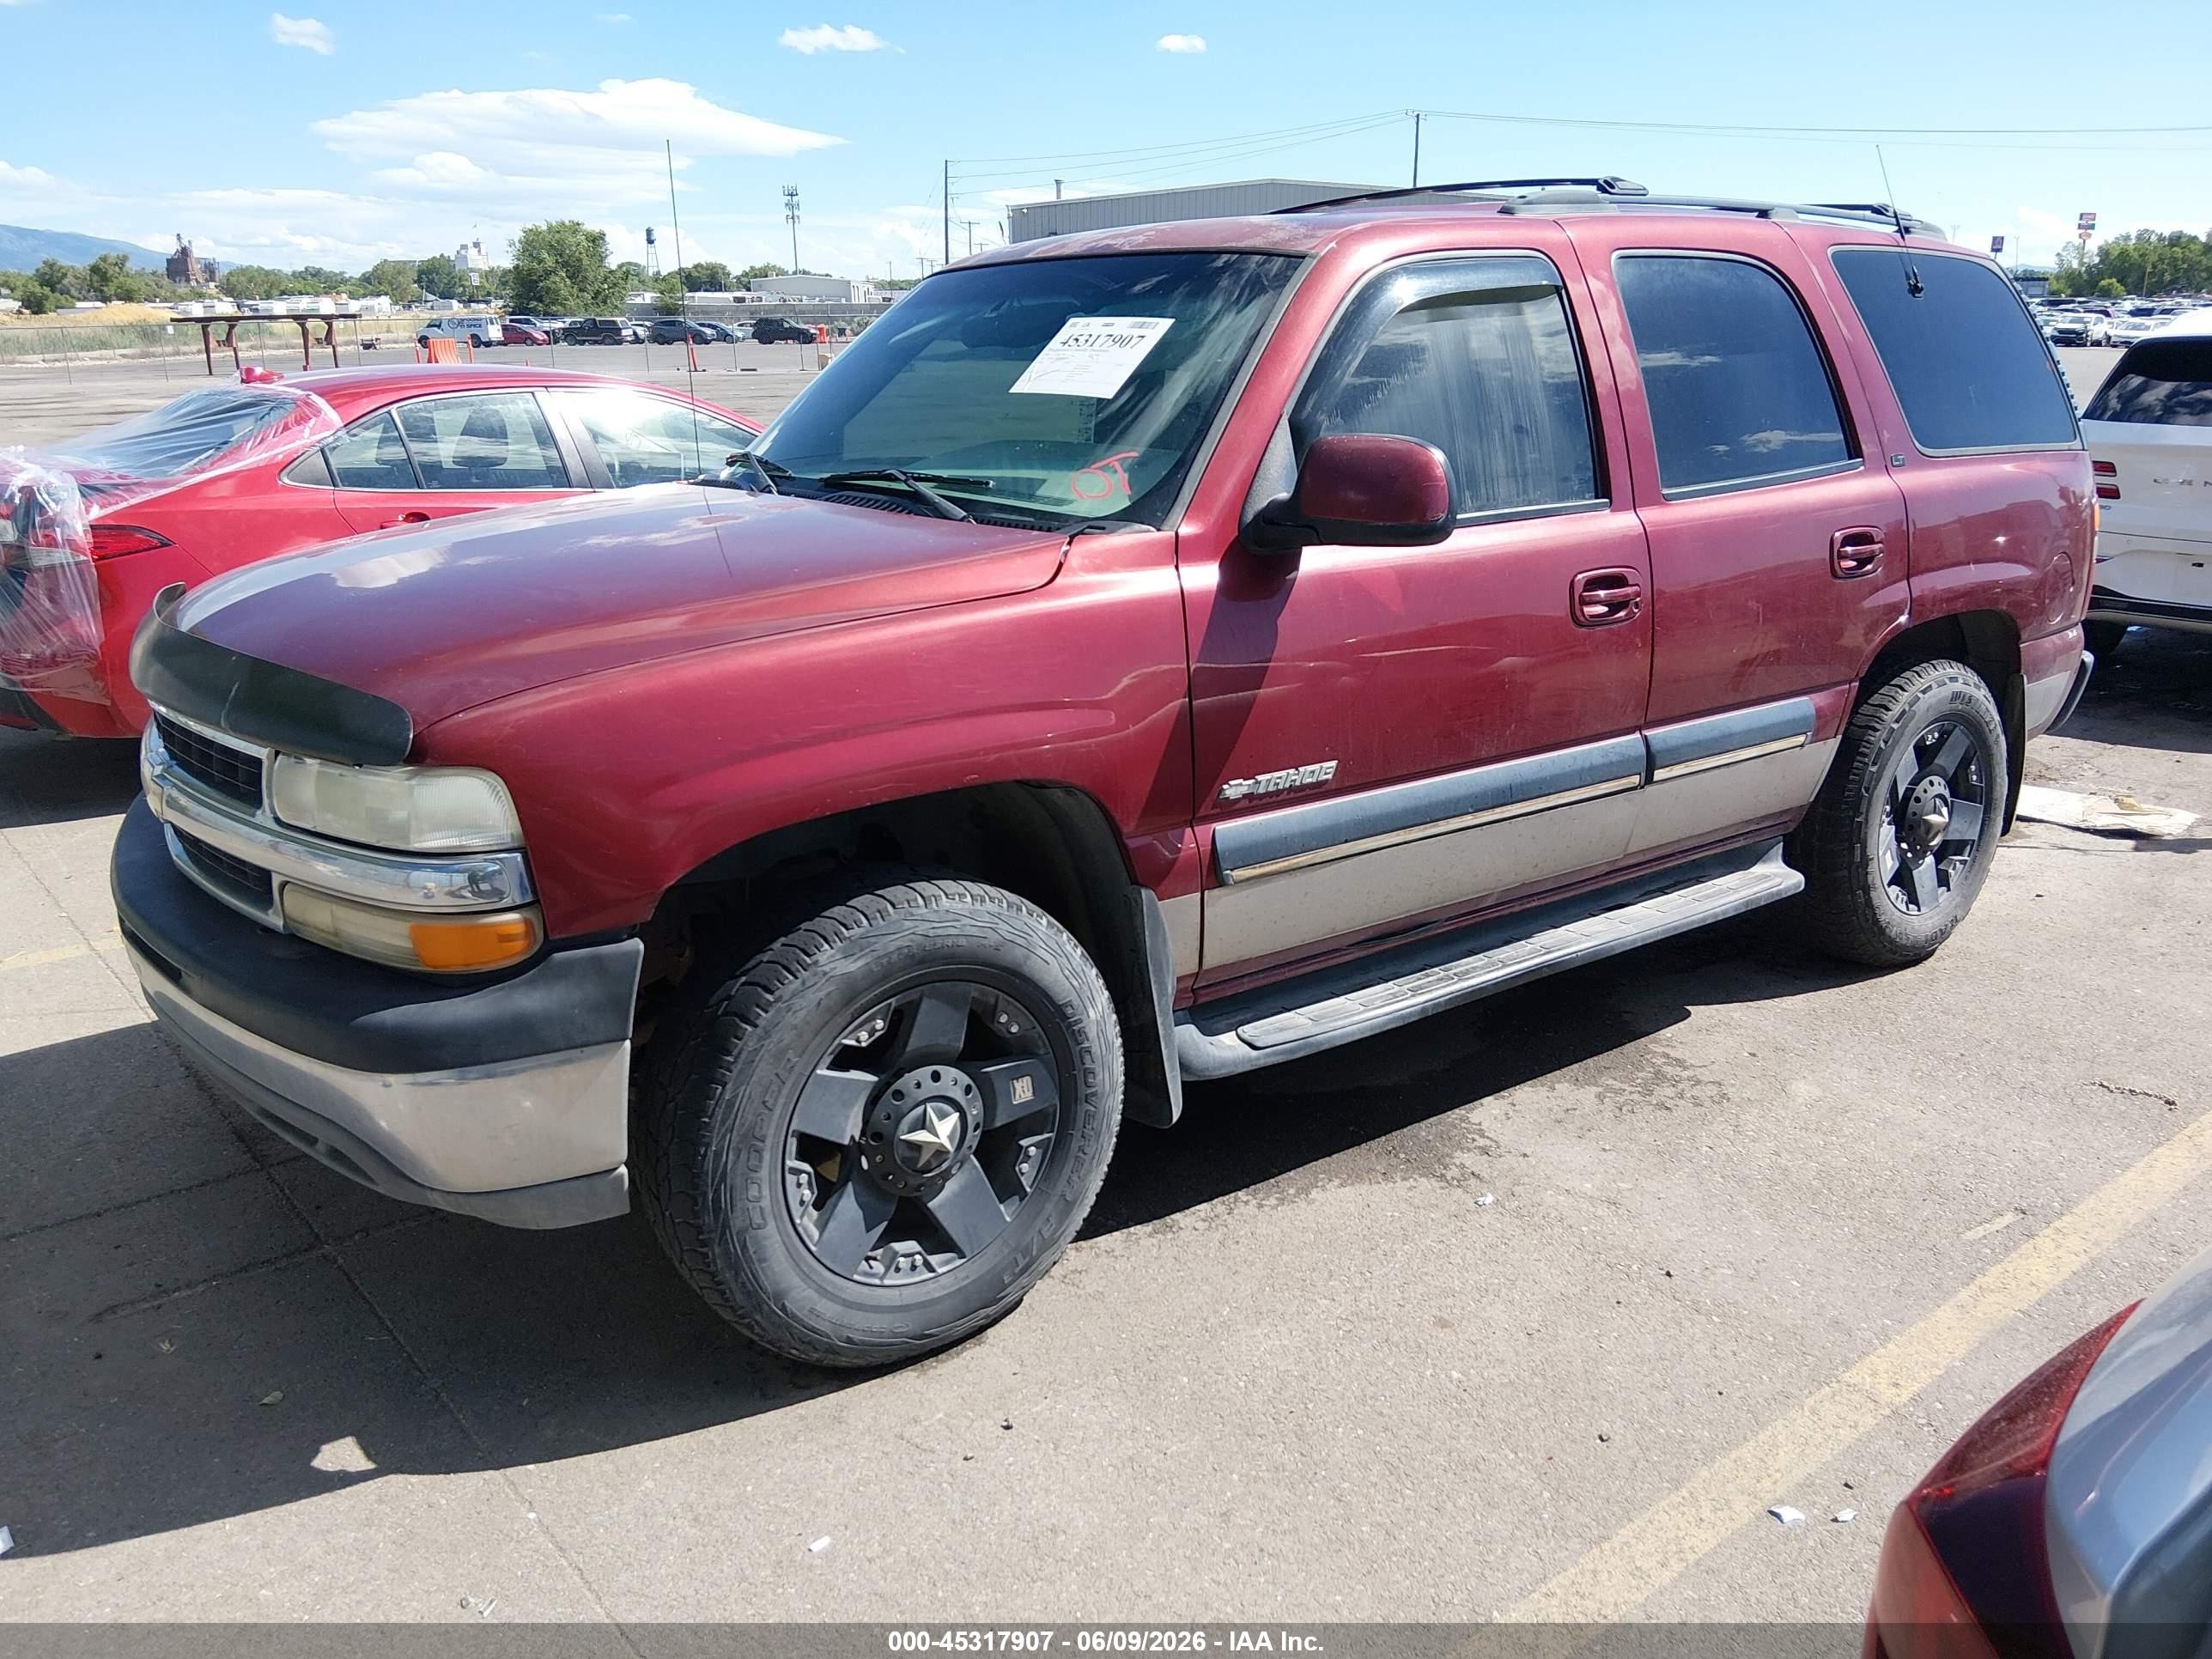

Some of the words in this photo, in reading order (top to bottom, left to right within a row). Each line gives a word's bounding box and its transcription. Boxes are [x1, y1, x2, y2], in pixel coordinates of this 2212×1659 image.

[1060, 333, 1147, 349] 45317907
[1255, 760, 1339, 795] TAHOE
[745, 1048, 801, 1231] COOPER
[1058, 997, 1100, 1203] DISCOVERER
